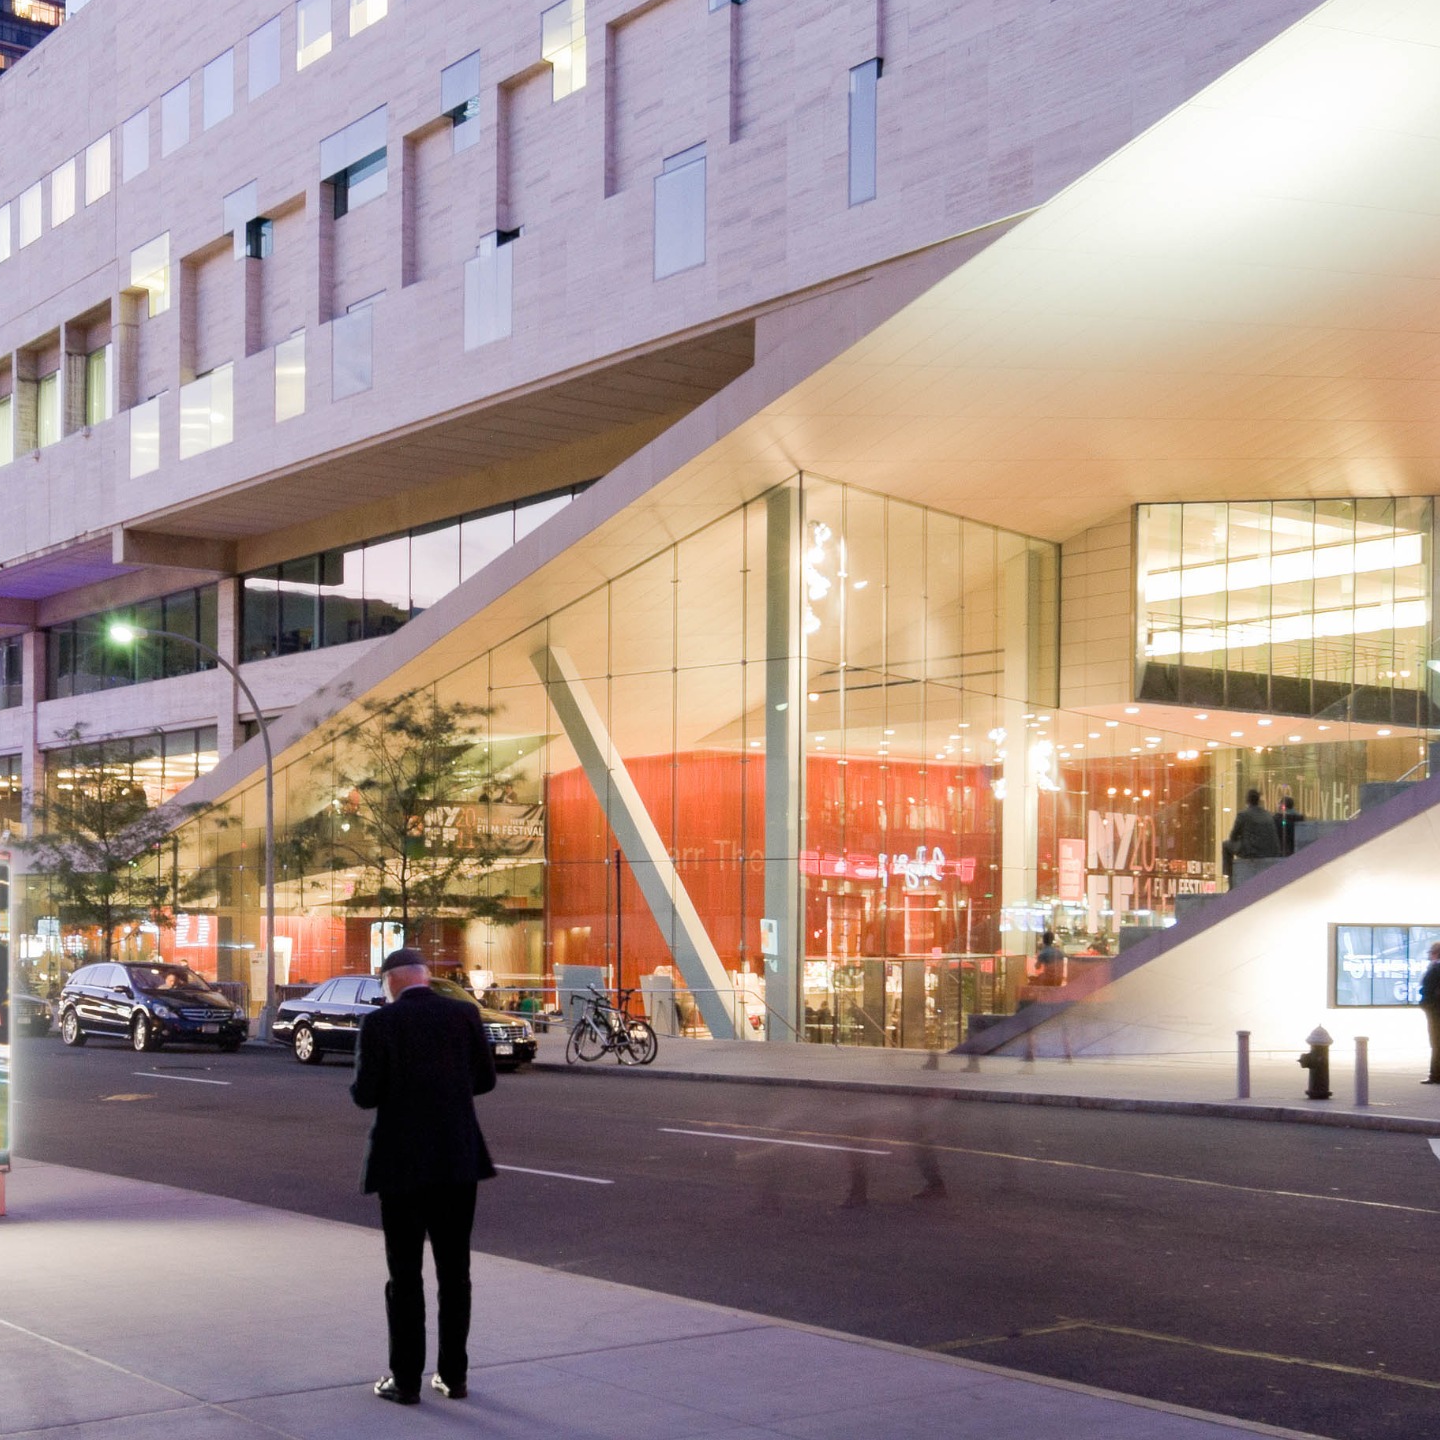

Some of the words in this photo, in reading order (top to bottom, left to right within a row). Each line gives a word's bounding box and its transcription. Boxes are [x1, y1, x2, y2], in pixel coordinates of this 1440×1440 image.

[423, 806, 461, 827] NY
[456, 807, 476, 828] 20
[477, 824, 500, 835] FILM
[502, 825, 545, 836] FESTIVAL
[1087, 810, 1137, 870] NY
[1129, 815, 1157, 872] 20
[670, 848, 705, 871] arr
[712, 839, 765, 872] The
[1187, 860, 1201, 874] NEW
[1087, 874, 1134, 935] FF
